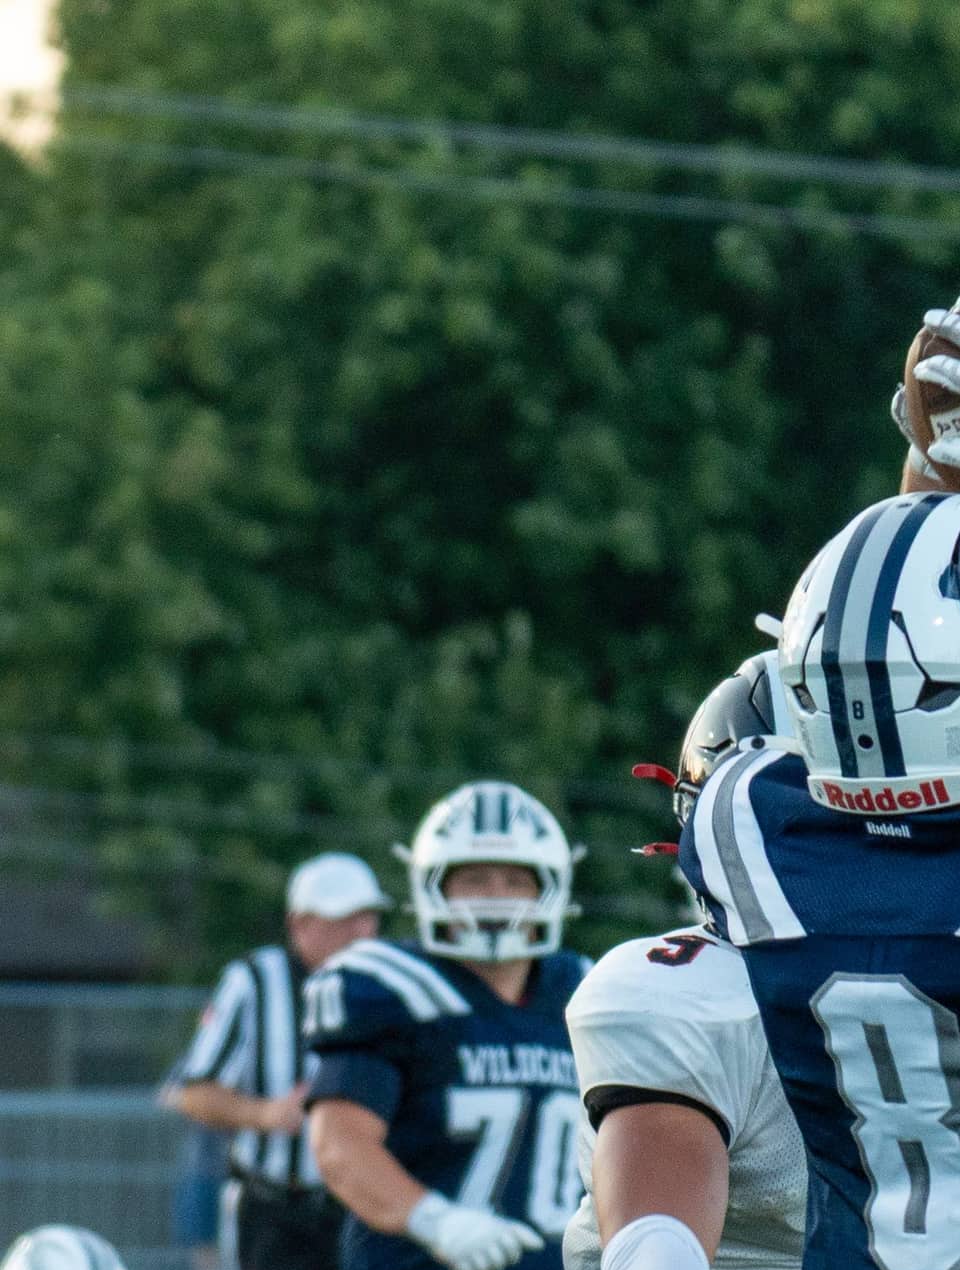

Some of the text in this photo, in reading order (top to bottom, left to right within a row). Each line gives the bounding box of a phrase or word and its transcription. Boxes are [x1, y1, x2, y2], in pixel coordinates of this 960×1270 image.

[852, 700, 865, 721] 8
[822, 778, 951, 813] Riddell
[864, 821, 913, 839] Riddell
[447, 1088, 582, 1234] 70
